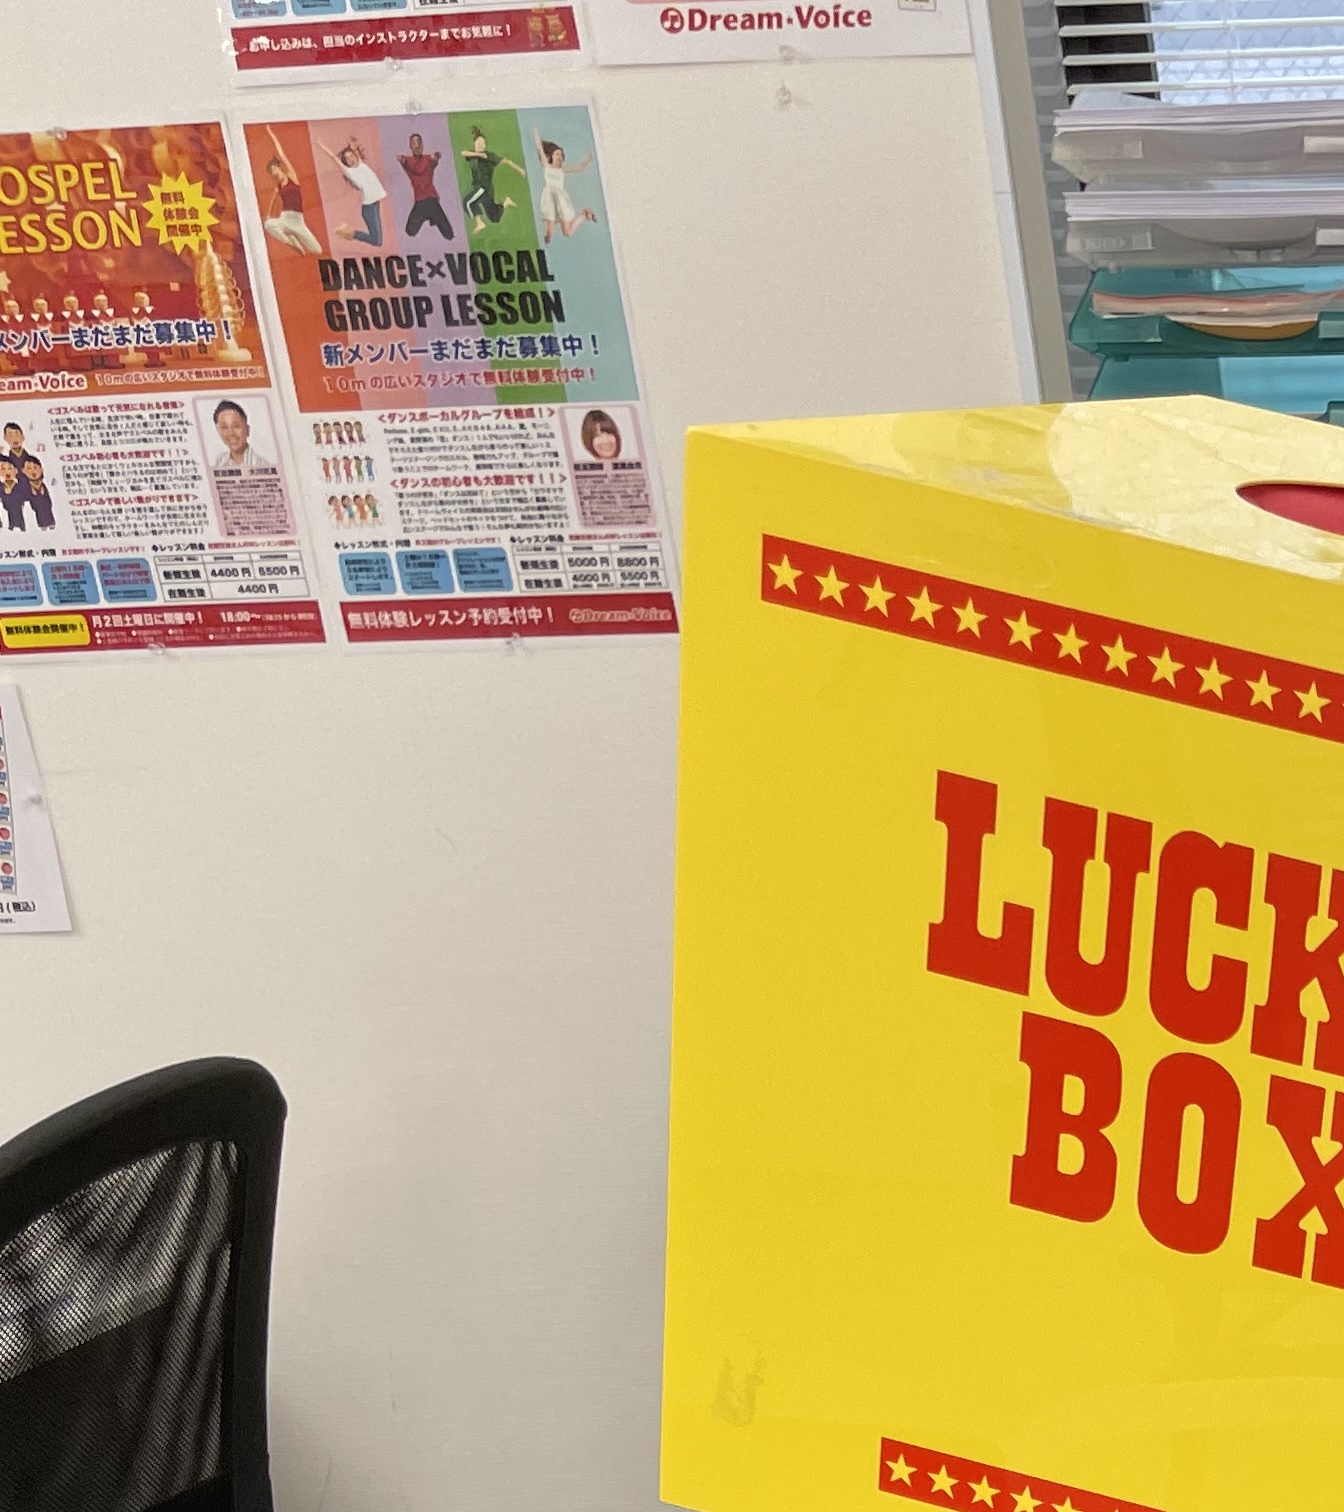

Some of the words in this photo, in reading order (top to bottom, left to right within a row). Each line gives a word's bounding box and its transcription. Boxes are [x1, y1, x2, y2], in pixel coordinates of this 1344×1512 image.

[0, 160, 137, 207] OSPEL
[0, 208, 142, 254] ESSON
[324, 296, 434, 332] GROUP
[442, 289, 566, 326] LESSON
